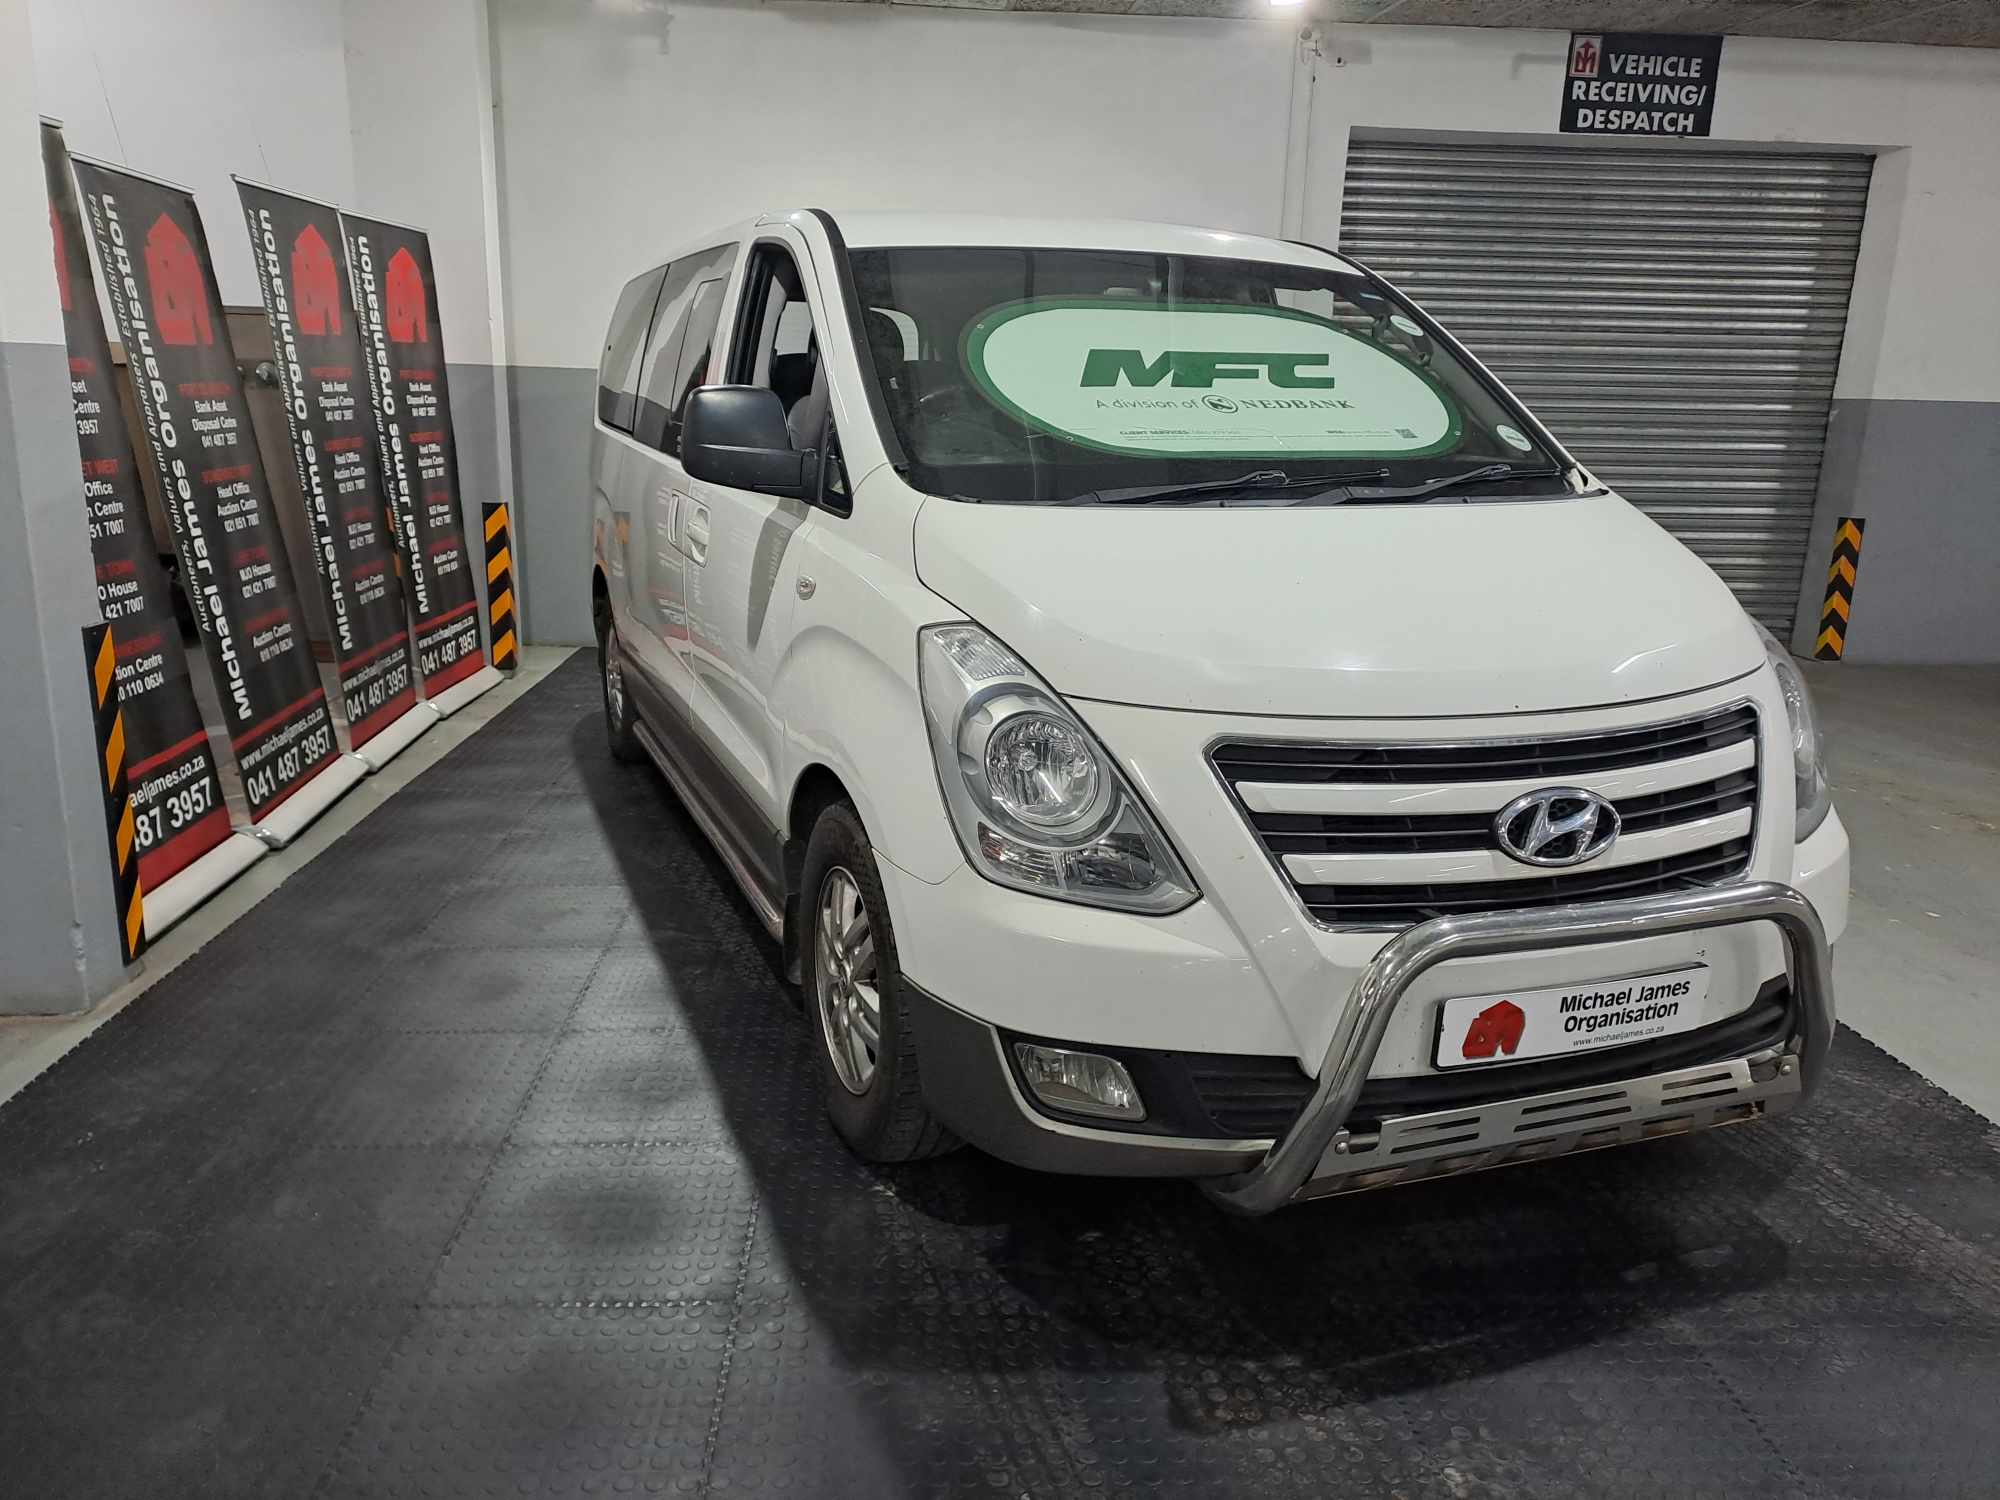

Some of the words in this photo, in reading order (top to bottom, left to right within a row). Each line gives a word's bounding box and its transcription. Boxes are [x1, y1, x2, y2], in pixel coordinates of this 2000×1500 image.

[1609, 53, 1702, 78] VEHICLE
[1571, 80, 1707, 106] RECEIVING/
[1576, 108, 1694, 133] DESPATCH
[88, 193, 106, 235] 1964
[99, 240, 131, 337] Established
[102, 194, 177, 448] Organisation
[259, 209, 307, 420] Organisation
[358, 236, 395, 415] Organisation
[1080, 349, 1335, 388] MFC
[130, 351, 159, 439] Appraisers
[1096, 399, 1109, 408] A
[1112, 399, 1178, 409] division
[1181, 399, 1199, 409] of
[1240, 399, 1356, 409] NEDBANK
[77, 419, 99, 435] 3957
[152, 441, 167, 472] and
[389, 423, 411, 508] James
[84, 481, 113, 497] Office
[302, 430, 329, 527] James
[95, 501, 124, 517] Centre
[163, 477, 183, 533] Valuers
[172, 459, 213, 575] James
[104, 519, 125, 536] 7007
[403, 515, 429, 614] Michael
[105, 603, 123, 619] 421
[124, 596, 144, 615] 7007
[107, 580, 138, 598] House
[320, 535, 352, 650] Michael
[135, 653, 163, 673] Centre
[203, 584, 252, 720] Michael
[421, 649, 440, 675] 041
[441, 641, 456, 664] 487
[459, 630, 476, 656] 3957
[346, 691, 367, 722] 041
[368, 678, 385, 707] 487
[386, 664, 408, 695] 3957
[248, 765, 276, 805] 041
[278, 746, 300, 782] 487
[302, 725, 331, 764] 3957
[166, 776, 212, 828] 3957
[1560, 987, 1632, 1013] Michael
[1635, 980, 1690, 1003] James
[1564, 1002, 1679, 1032] Organisation
[1573, 1026, 1664, 1046] www.michaeljames.co.za
